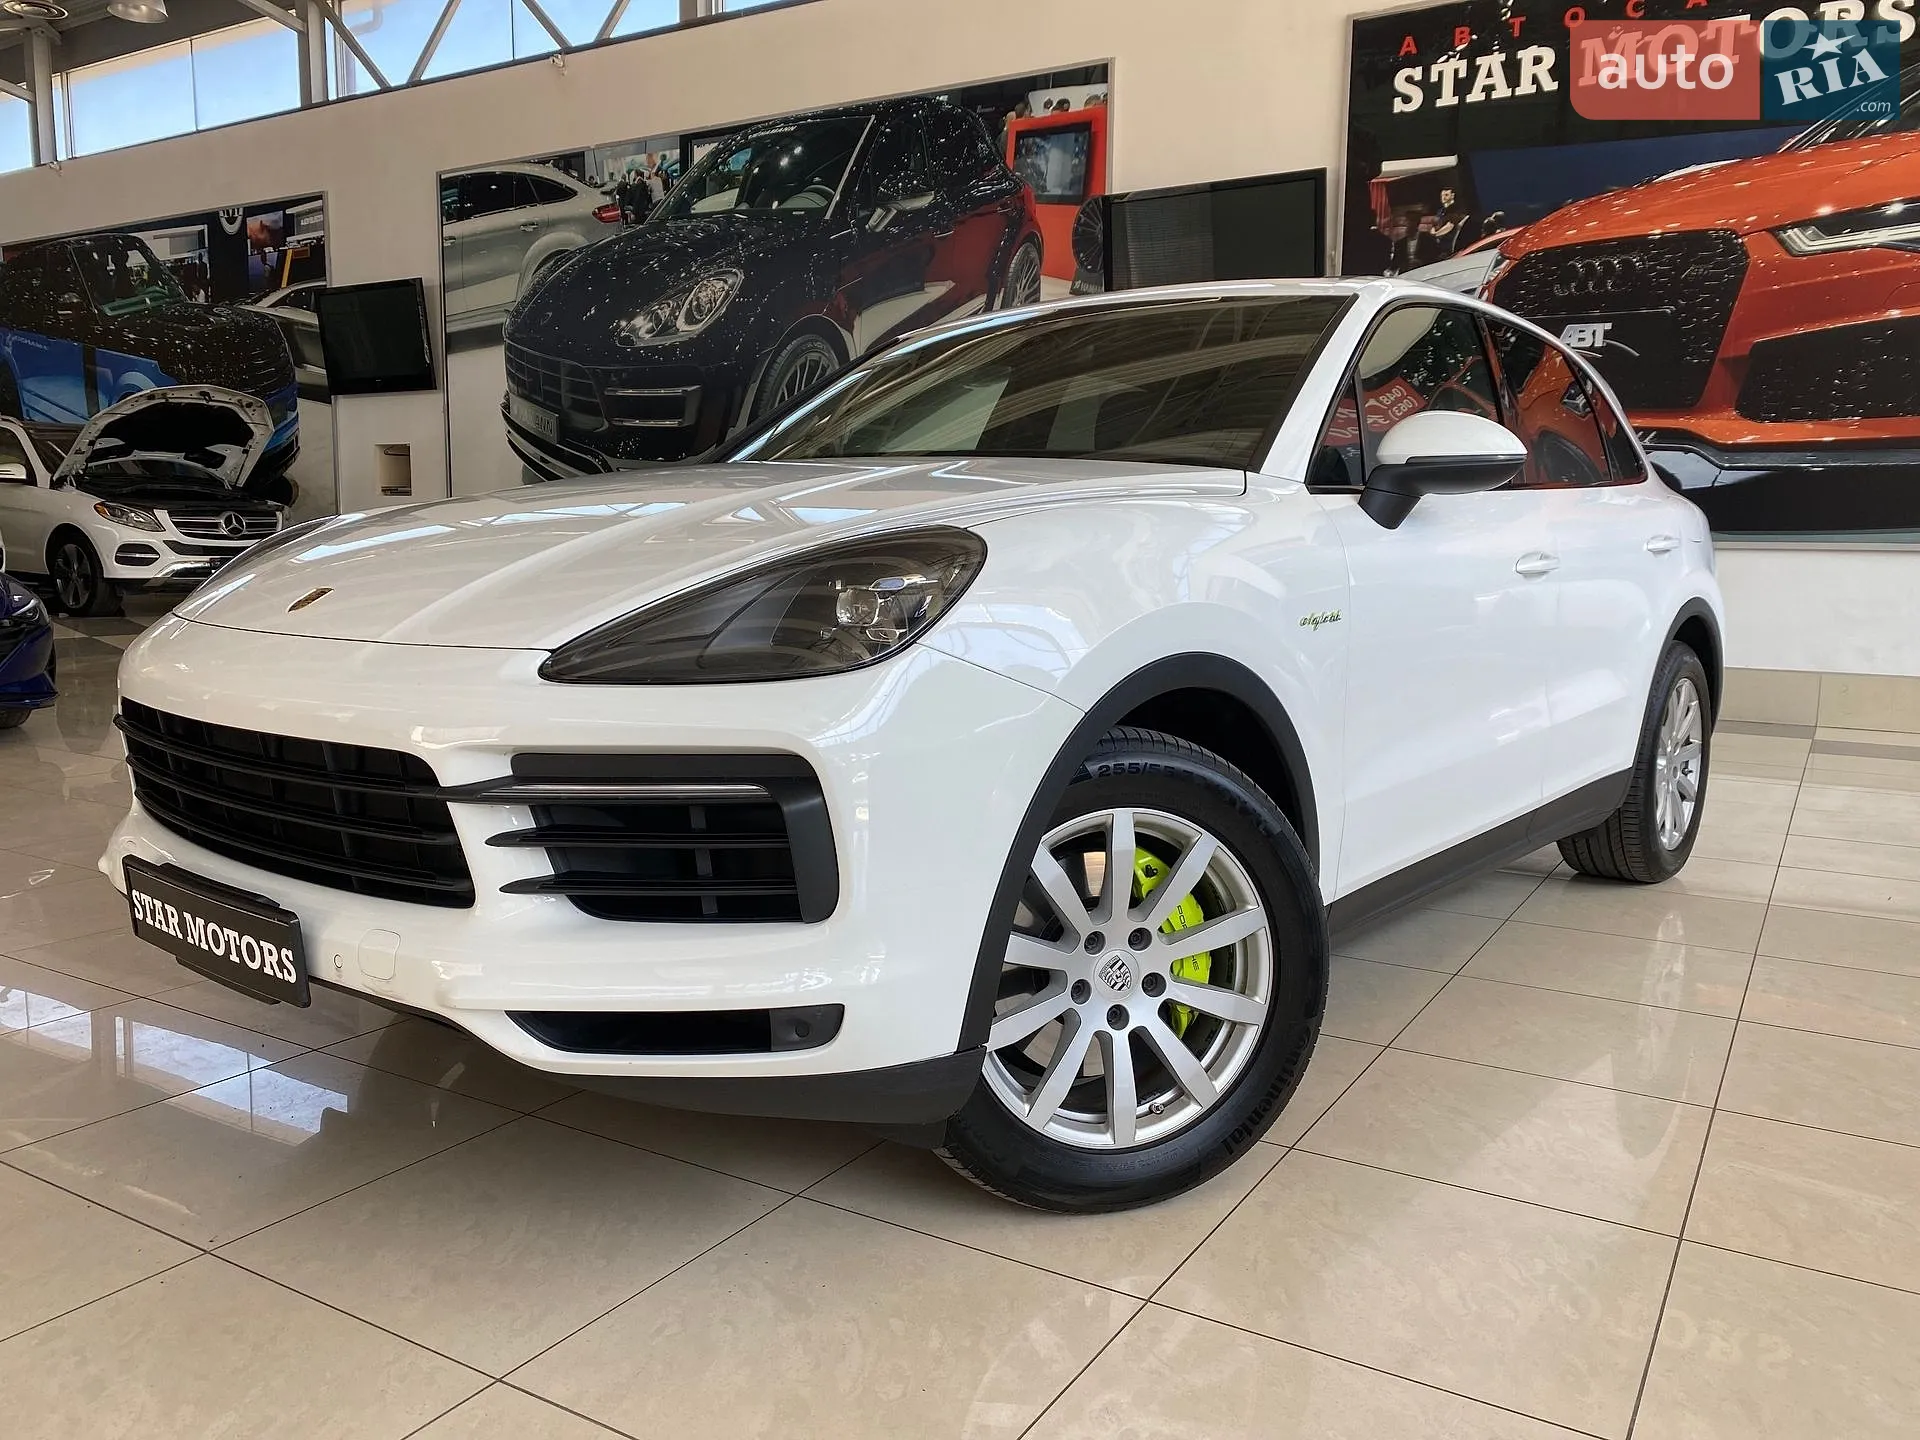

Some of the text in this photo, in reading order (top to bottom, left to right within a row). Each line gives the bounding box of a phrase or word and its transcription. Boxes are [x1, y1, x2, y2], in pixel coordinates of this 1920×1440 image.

[1393, 44, 1559, 113] STAR
[1561, 322, 1613, 348] ABT
[131, 888, 298, 984] STAR MOTORS
